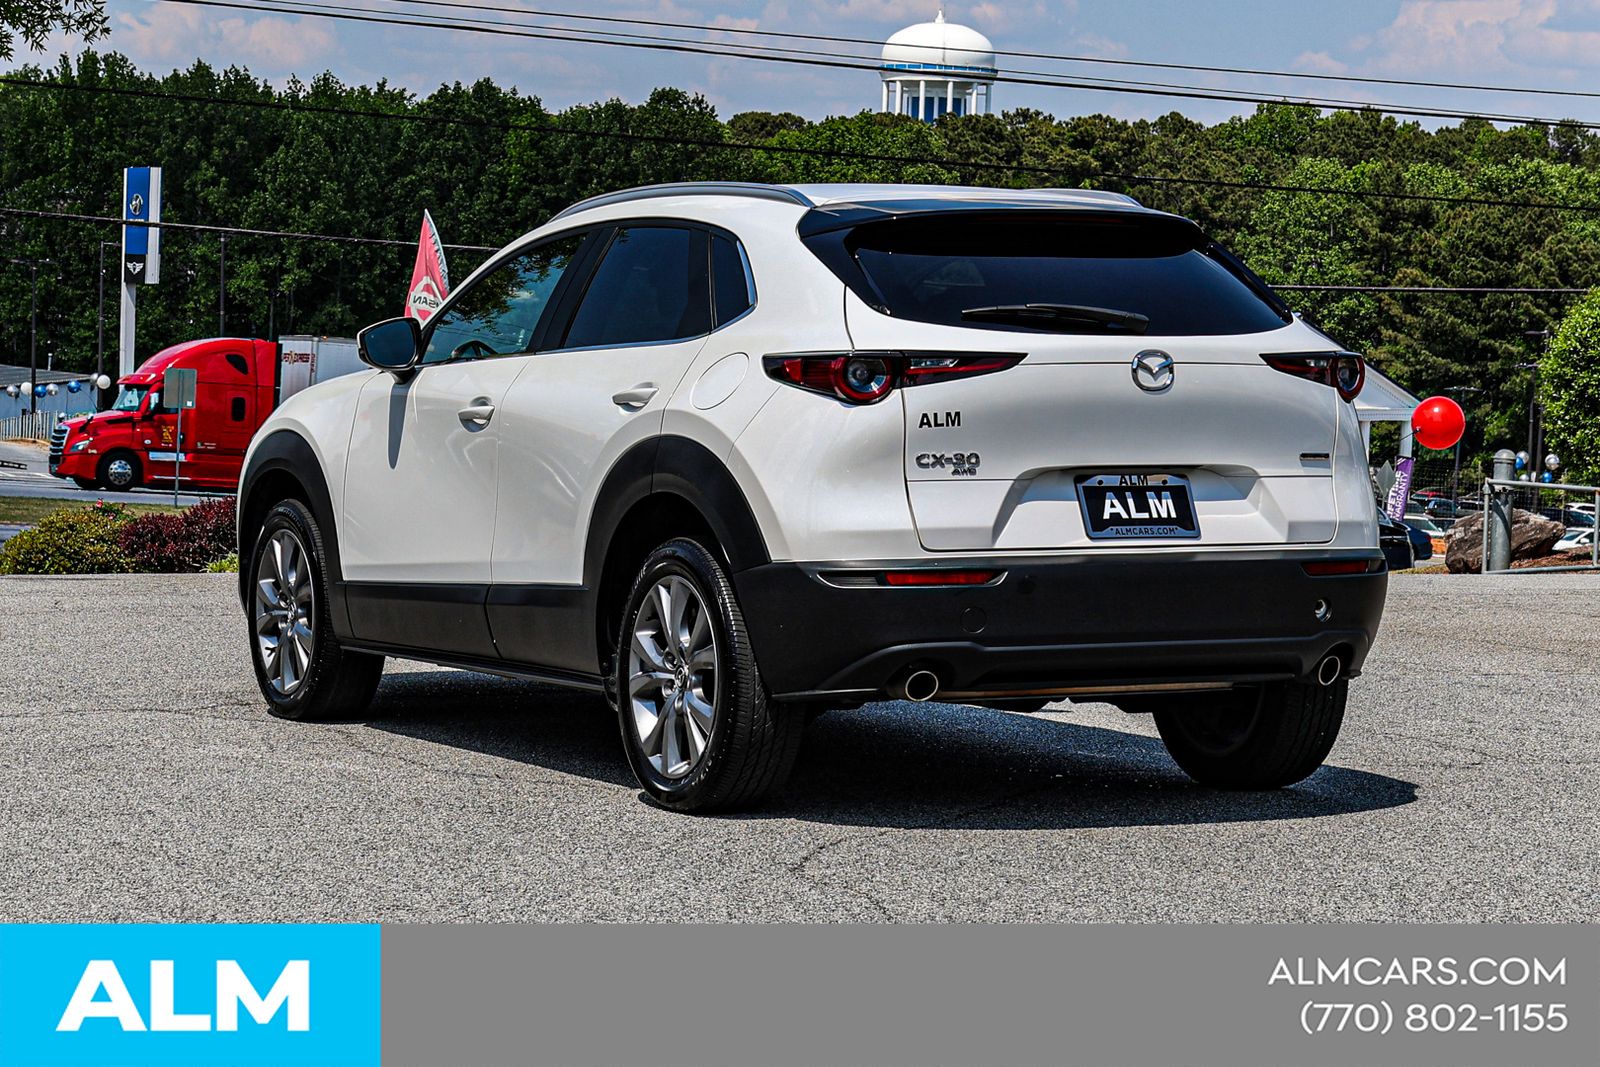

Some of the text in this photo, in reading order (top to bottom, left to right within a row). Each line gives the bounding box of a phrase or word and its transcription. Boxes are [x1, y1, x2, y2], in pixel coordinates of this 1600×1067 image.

[918, 411, 961, 428] ALM
[915, 453, 980, 469] CX-30
[951, 468, 977, 476] AWD
[1119, 475, 1149, 486] ALM
[1102, 491, 1177, 519] ALM
[1114, 526, 1176, 536] ALMCARS.COM
